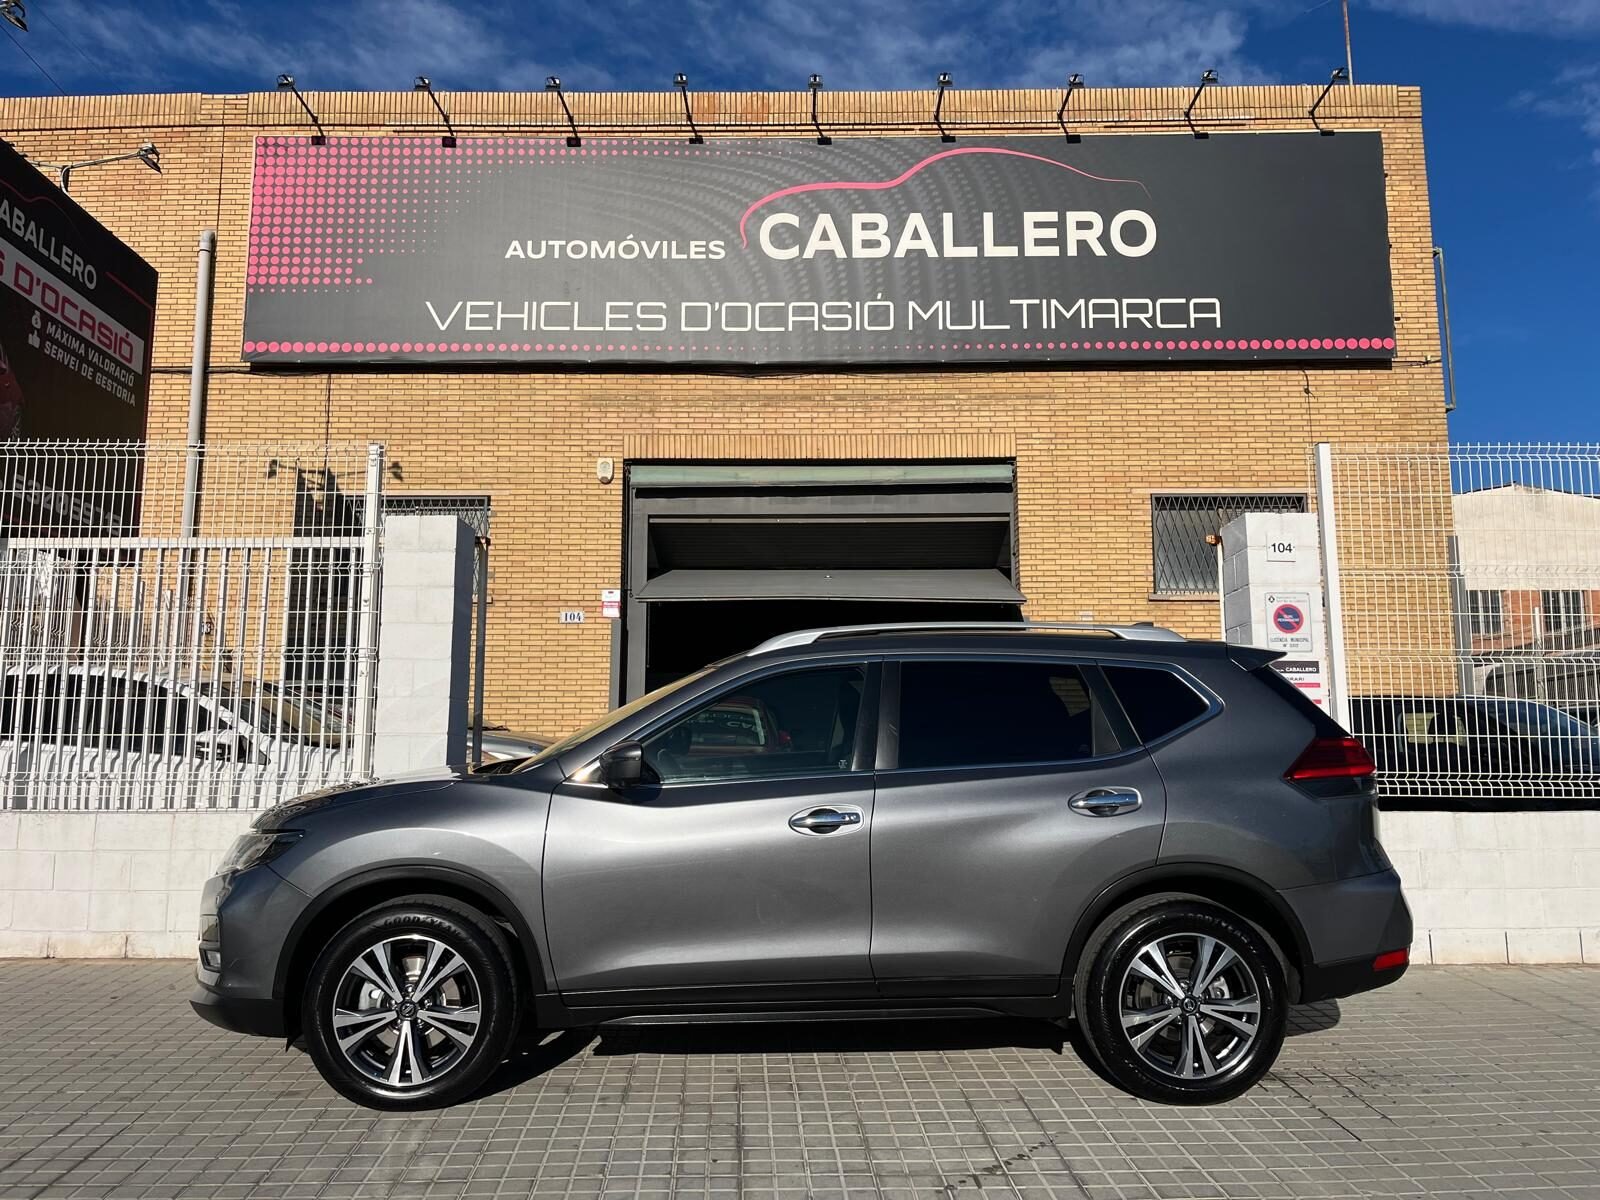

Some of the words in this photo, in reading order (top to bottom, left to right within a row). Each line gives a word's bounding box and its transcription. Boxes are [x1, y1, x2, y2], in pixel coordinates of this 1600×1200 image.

[504, 233, 726, 260] AUTOMÓVILES
[759, 209, 1157, 261] CABALLERO
[13, 261, 134, 364] D'OCASIÓ
[425, 301, 667, 332] VEHICLES
[681, 294, 895, 333] D'OCASIÓ
[908, 297, 1221, 331] MULTIMARCA
[43, 340, 80, 372] SERVEI
[81, 362, 94, 381] DE
[95, 372, 136, 407] GESTORIA
[88, 347, 135, 387] VALORACIÓ
[1271, 542, 1293, 553] 104
[563, 612, 581, 622] 104
